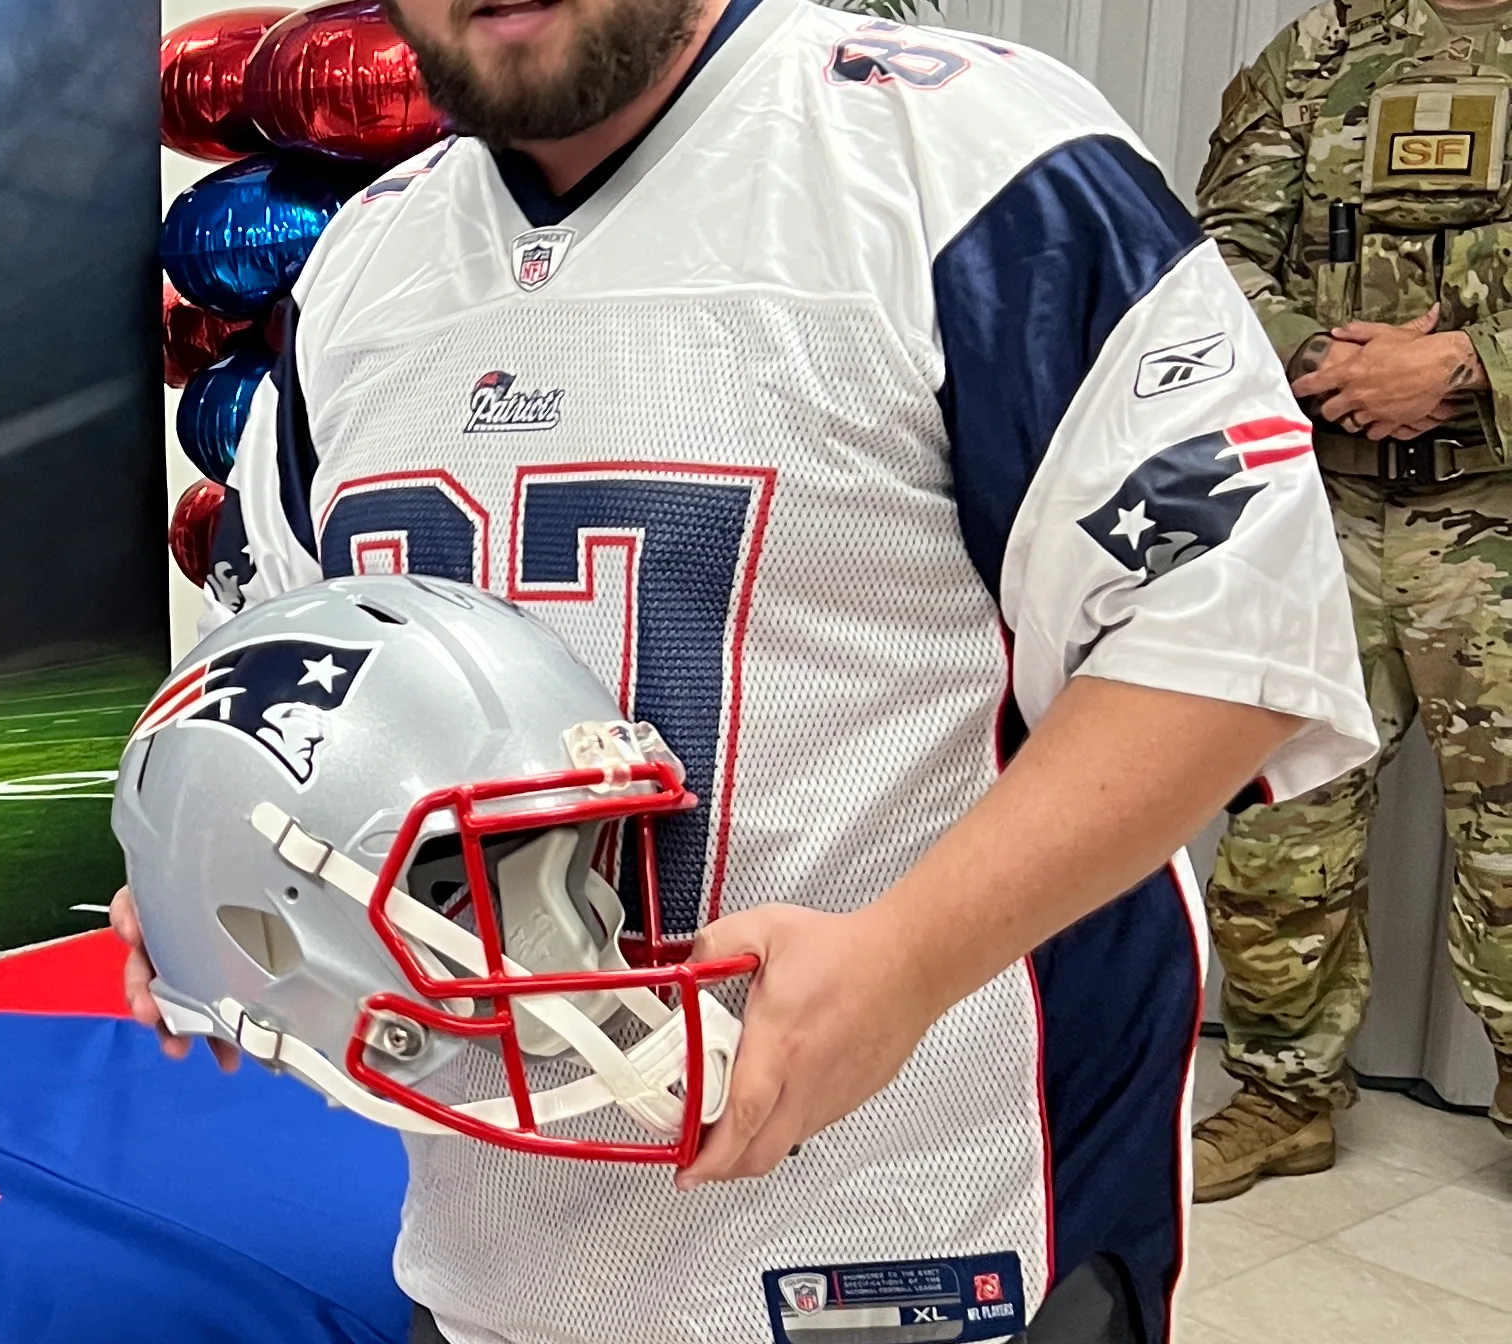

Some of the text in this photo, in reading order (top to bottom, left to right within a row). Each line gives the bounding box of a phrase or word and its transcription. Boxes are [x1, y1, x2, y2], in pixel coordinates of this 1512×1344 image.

[1399, 136, 1467, 167] SF
[521, 261, 548, 281] NFL
[913, 1305, 949, 1324] XL
